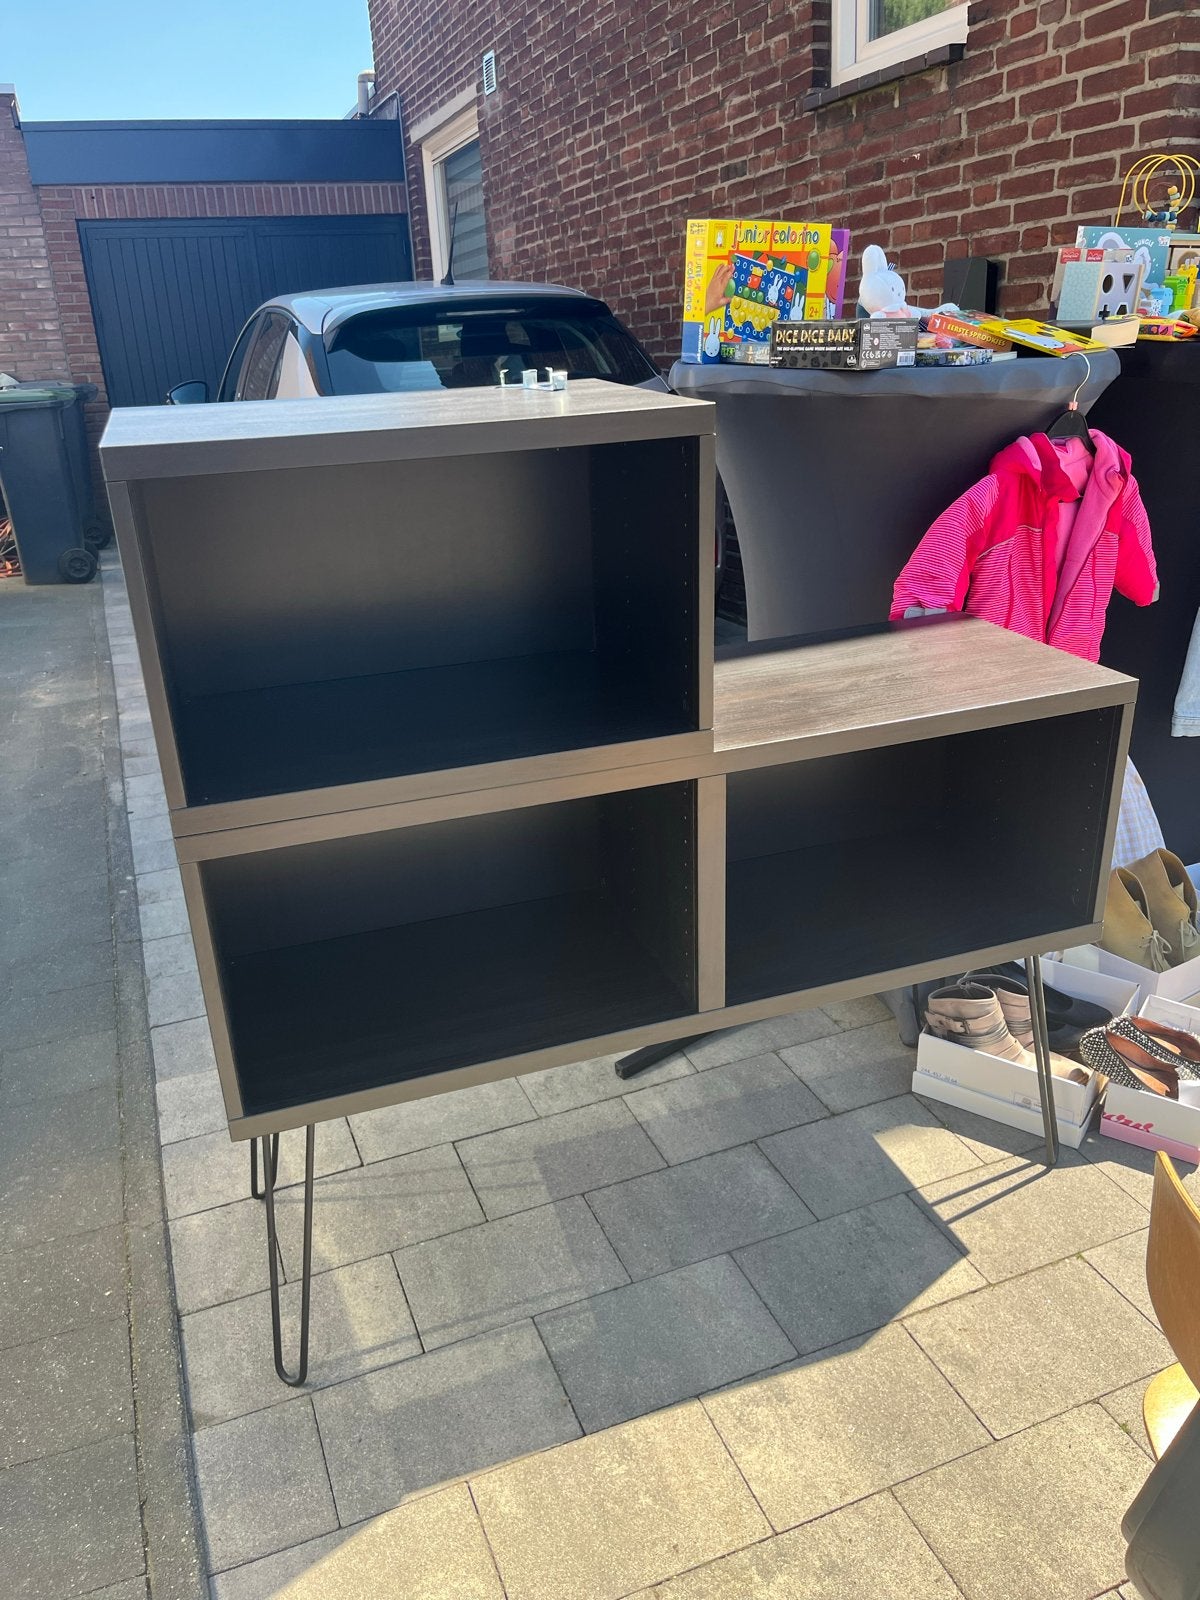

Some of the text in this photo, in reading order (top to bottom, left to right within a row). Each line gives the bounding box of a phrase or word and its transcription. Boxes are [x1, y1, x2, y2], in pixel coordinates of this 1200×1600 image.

[731, 224, 770, 250] junior
[772, 225, 820, 244] colorino
[1134, 238, 1155, 248] JUNGLE
[809, 306, 819, 318] 2+
[775, 329, 799, 344] DICE
[800, 329, 825, 344] DICE
[827, 328, 856, 343] BABY
[947, 323, 970, 337] EERSTE
